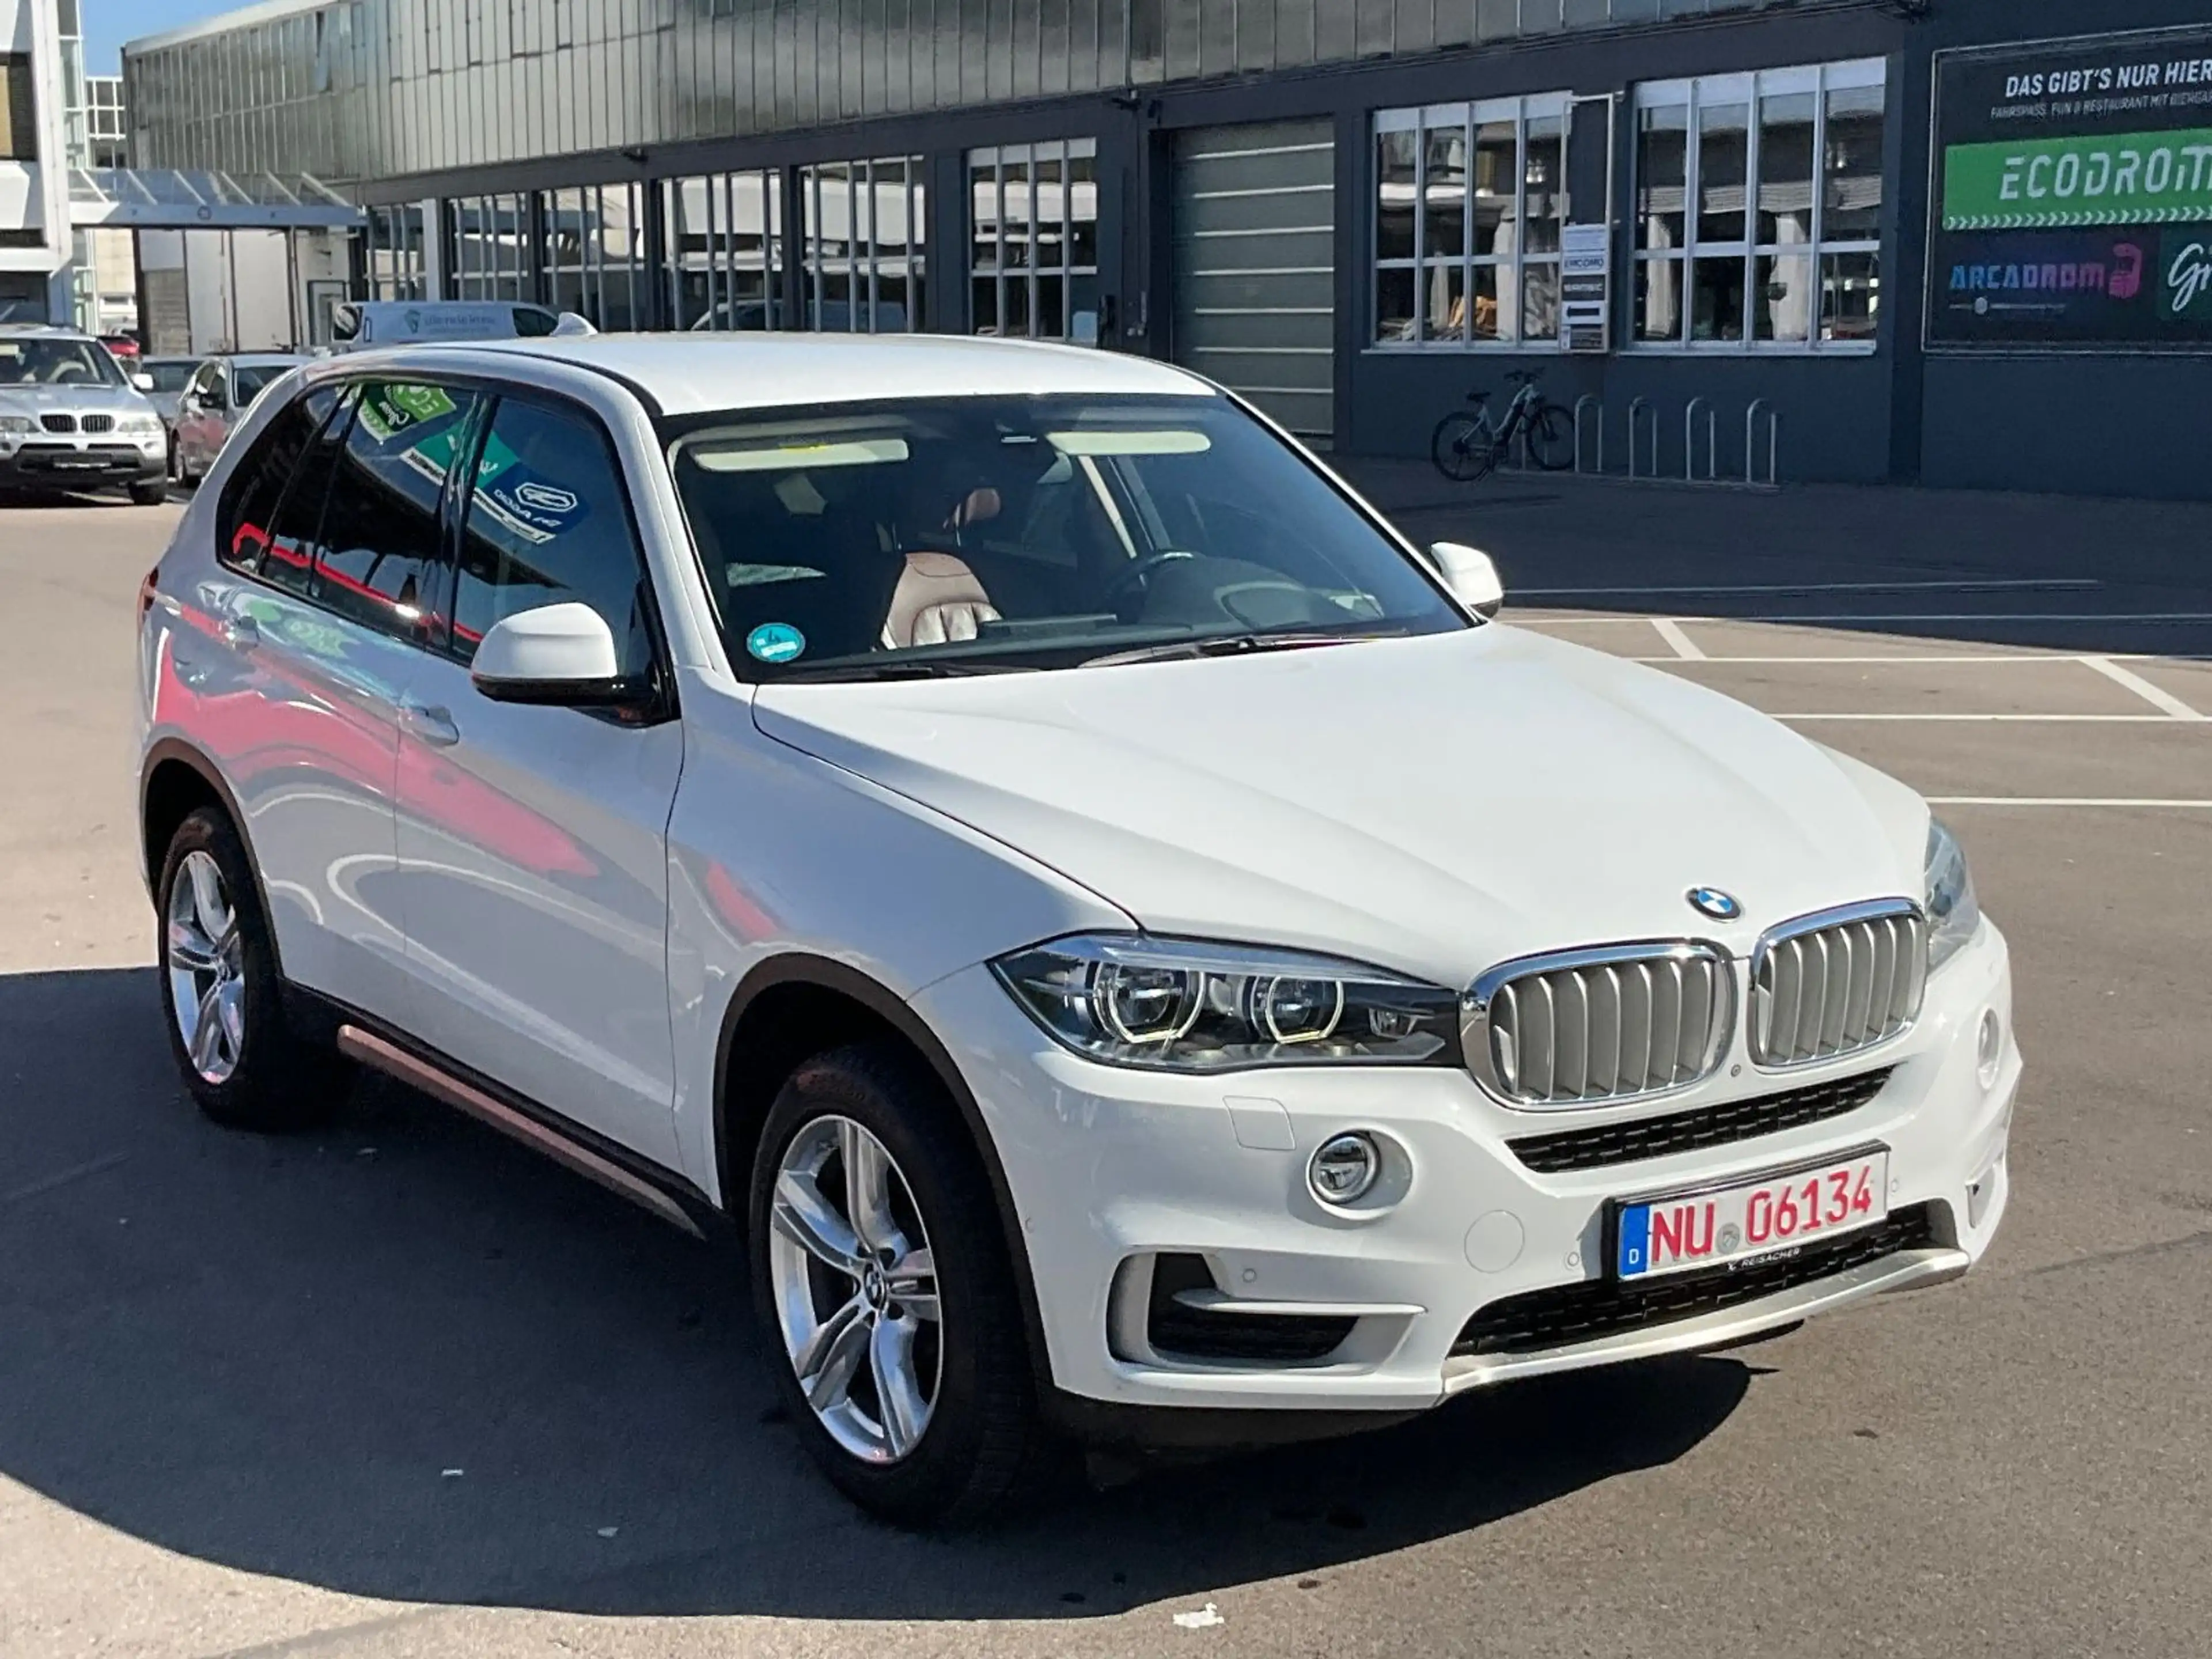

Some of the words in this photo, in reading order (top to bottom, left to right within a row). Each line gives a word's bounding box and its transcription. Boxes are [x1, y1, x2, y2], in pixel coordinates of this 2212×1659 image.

[2005, 75, 2043, 97] DAS
[2048, 67, 2112, 94] GIBT'S
[2116, 63, 2160, 89] NUR
[2164, 58, 2212, 84] HIER
[2150, 92, 2169, 108] MIT
[1652, 1201, 1715, 1264] NU
[1745, 1165, 1872, 1244] 06134
[1628, 1248, 1639, 1265] D
